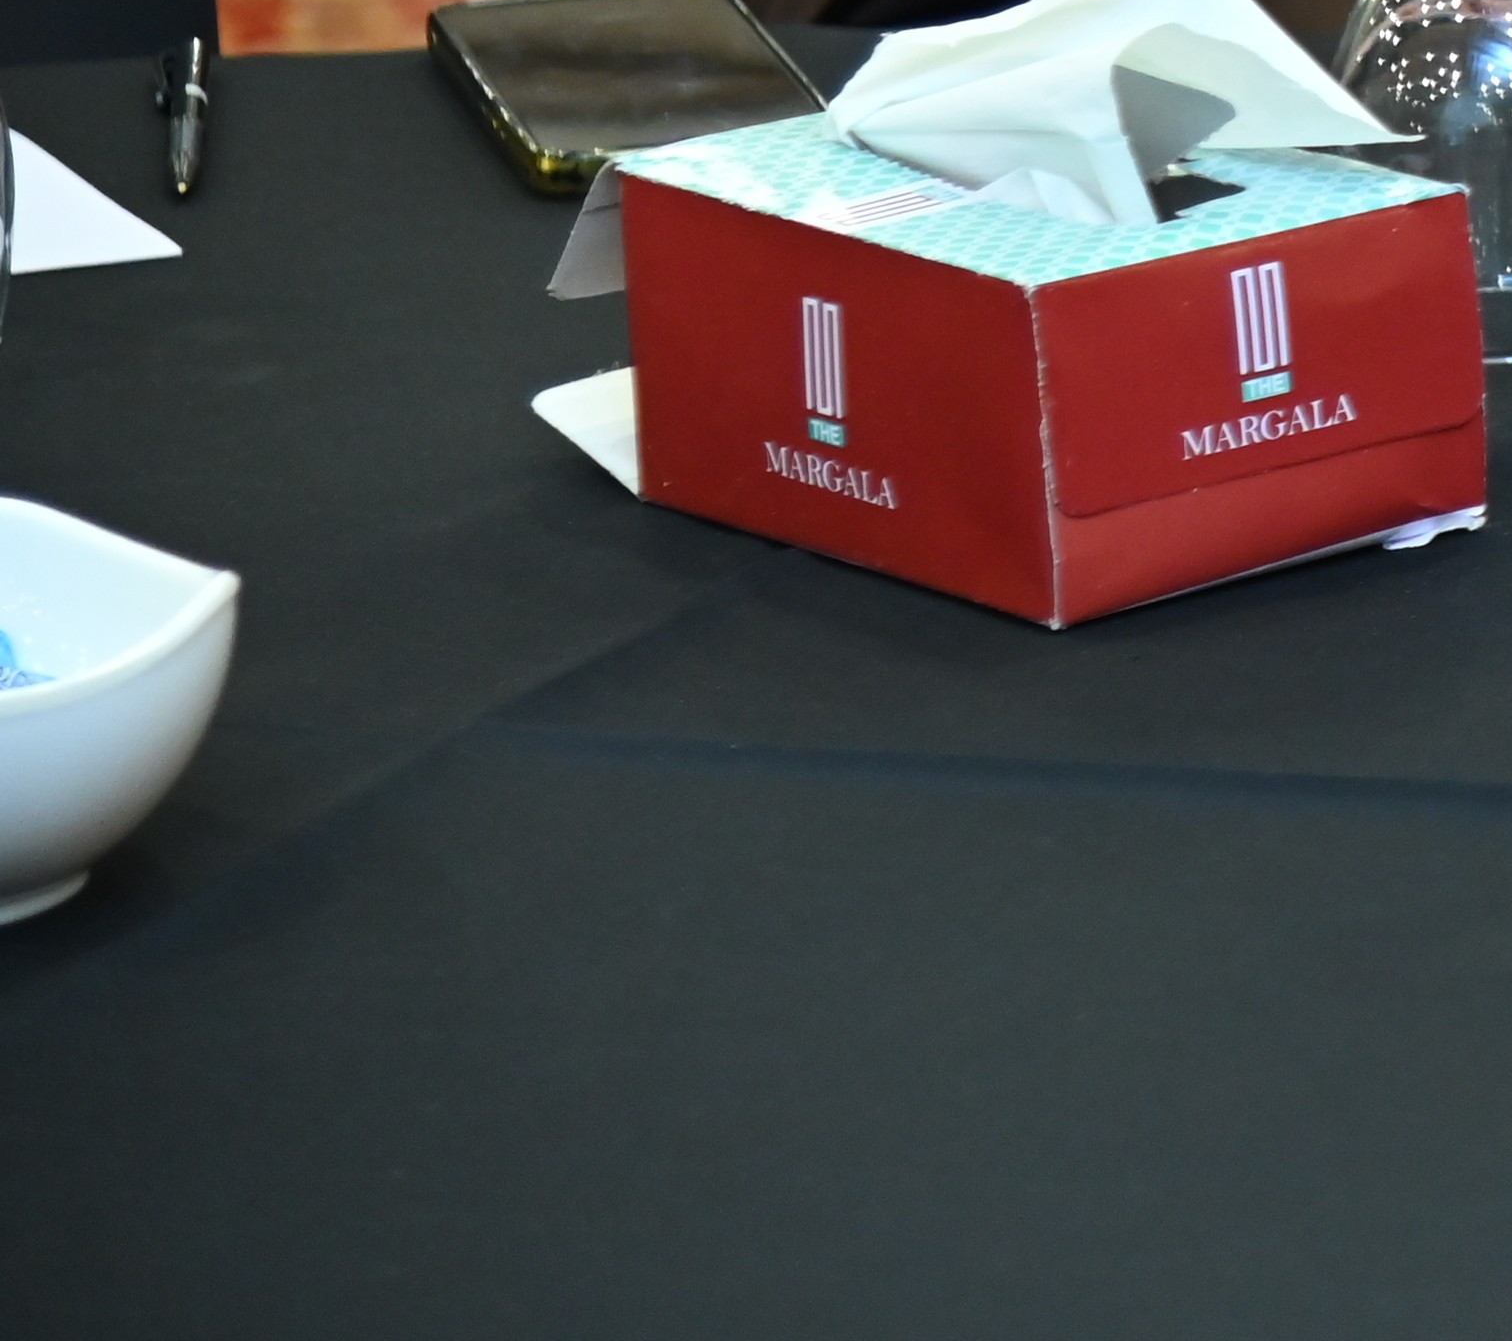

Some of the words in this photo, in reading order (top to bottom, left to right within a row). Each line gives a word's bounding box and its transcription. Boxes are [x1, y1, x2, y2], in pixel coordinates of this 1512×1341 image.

[1249, 375, 1286, 397] THE
[811, 419, 842, 446] THE
[1180, 394, 1357, 461] MARGALA
[764, 441, 898, 510] MARGALA
